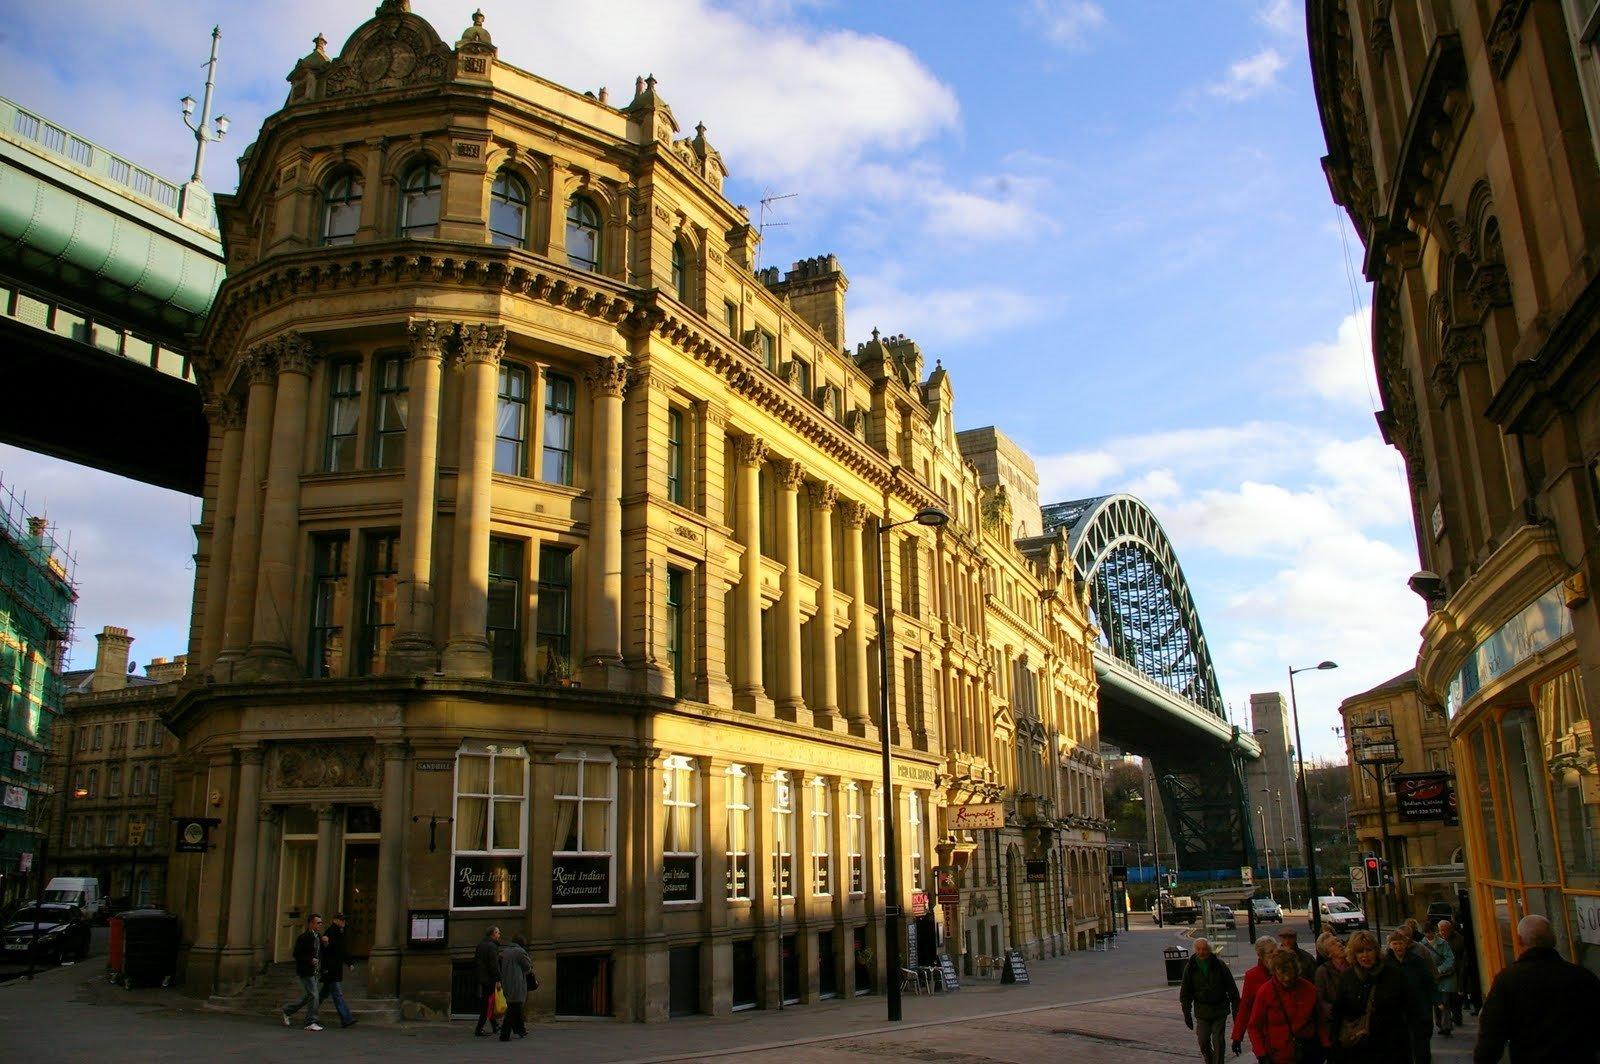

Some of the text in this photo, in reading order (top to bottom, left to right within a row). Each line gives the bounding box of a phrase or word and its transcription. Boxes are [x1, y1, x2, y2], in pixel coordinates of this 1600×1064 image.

[459, 867, 518, 885] Rani Indan
[552, 866, 606, 884] Rani Indian
[556, 884, 602, 897] Restaurant
